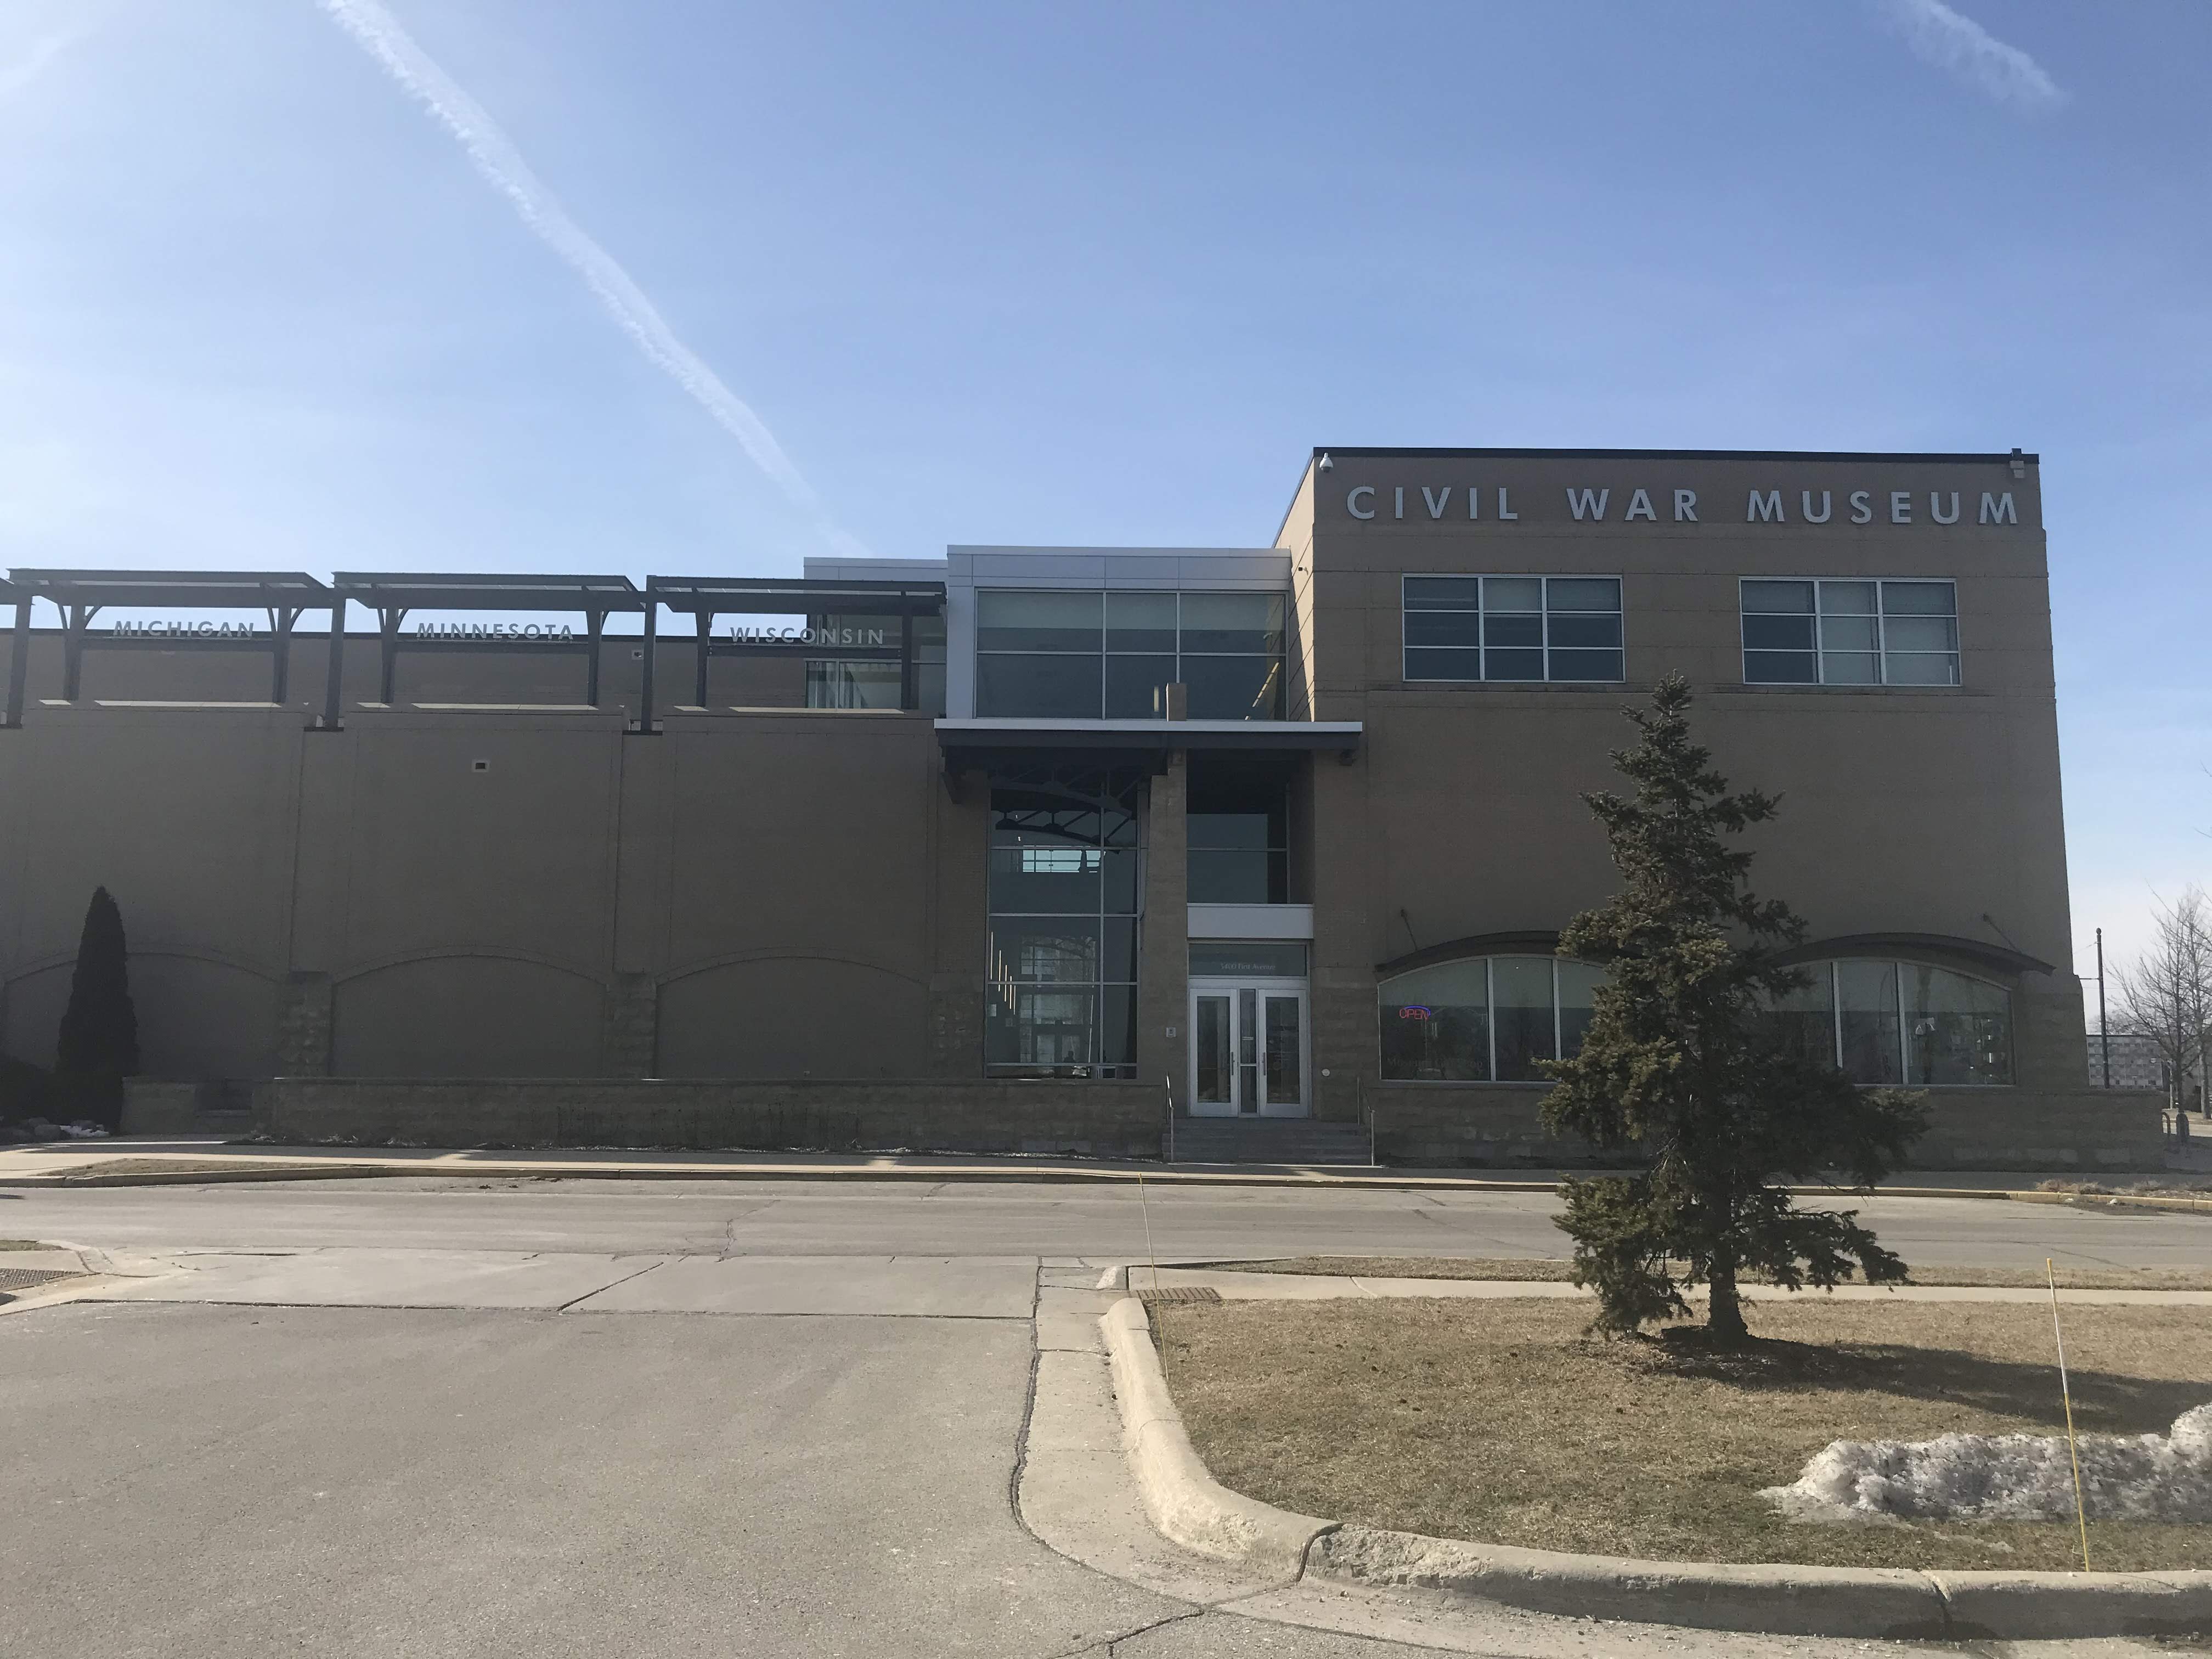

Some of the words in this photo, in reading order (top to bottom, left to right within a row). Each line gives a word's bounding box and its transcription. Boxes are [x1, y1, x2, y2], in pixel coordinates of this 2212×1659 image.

[1346, 486, 1518, 520] CIVIL
[1566, 488, 1699, 522] WAR
[1746, 489, 2018, 524] MUSEUM
[112, 620, 254, 637] MICHIGAN
[416, 622, 573, 640] MINNESOTA
[730, 627, 883, 645] WISCONSIN
[1399, 1008, 1429, 1020] OPEN
